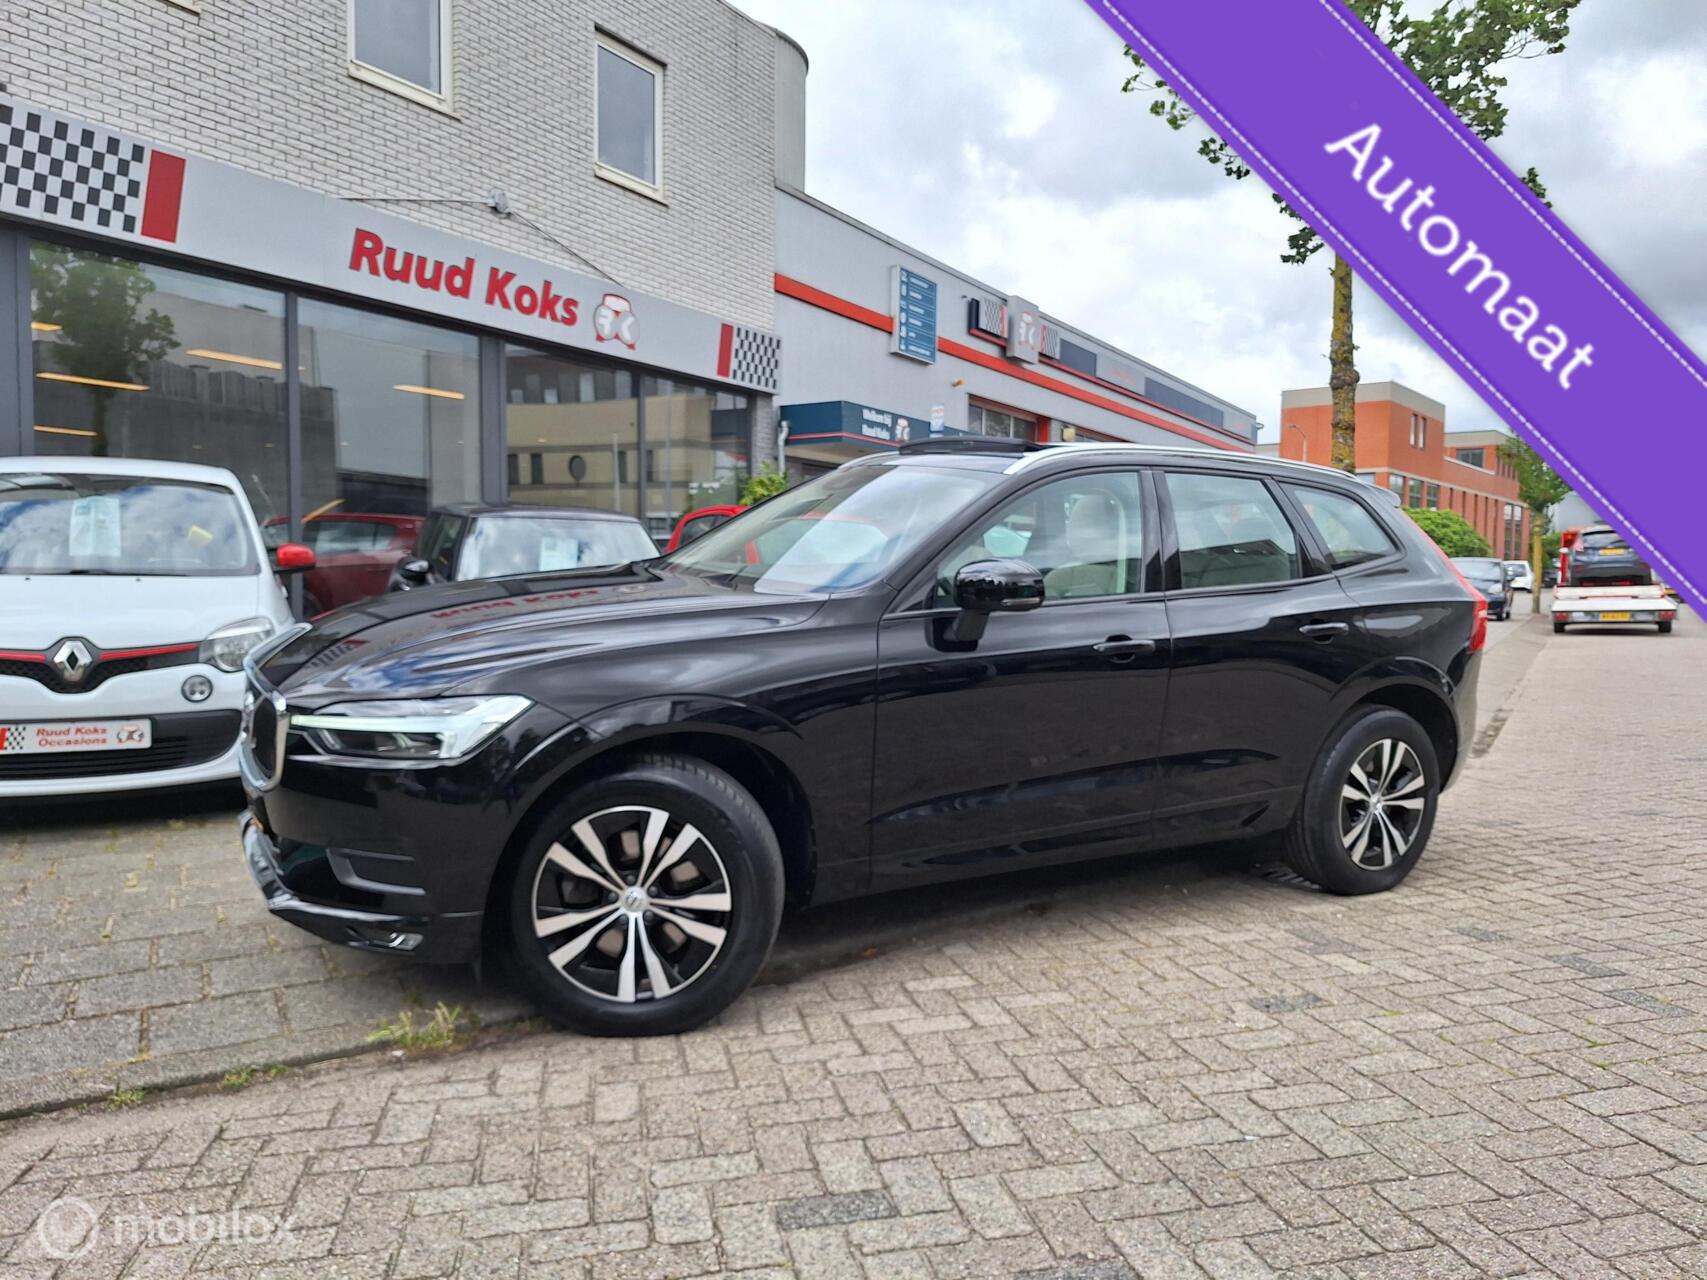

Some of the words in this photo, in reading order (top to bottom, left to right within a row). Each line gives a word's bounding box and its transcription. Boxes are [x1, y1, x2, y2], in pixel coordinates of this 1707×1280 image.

[349, 227, 475, 299] Ruud
[485, 266, 579, 327] Koks
[36, 727, 70, 736] Ruud
[74, 727, 107, 735] Koks
[38, 737, 107, 747] Occasions
